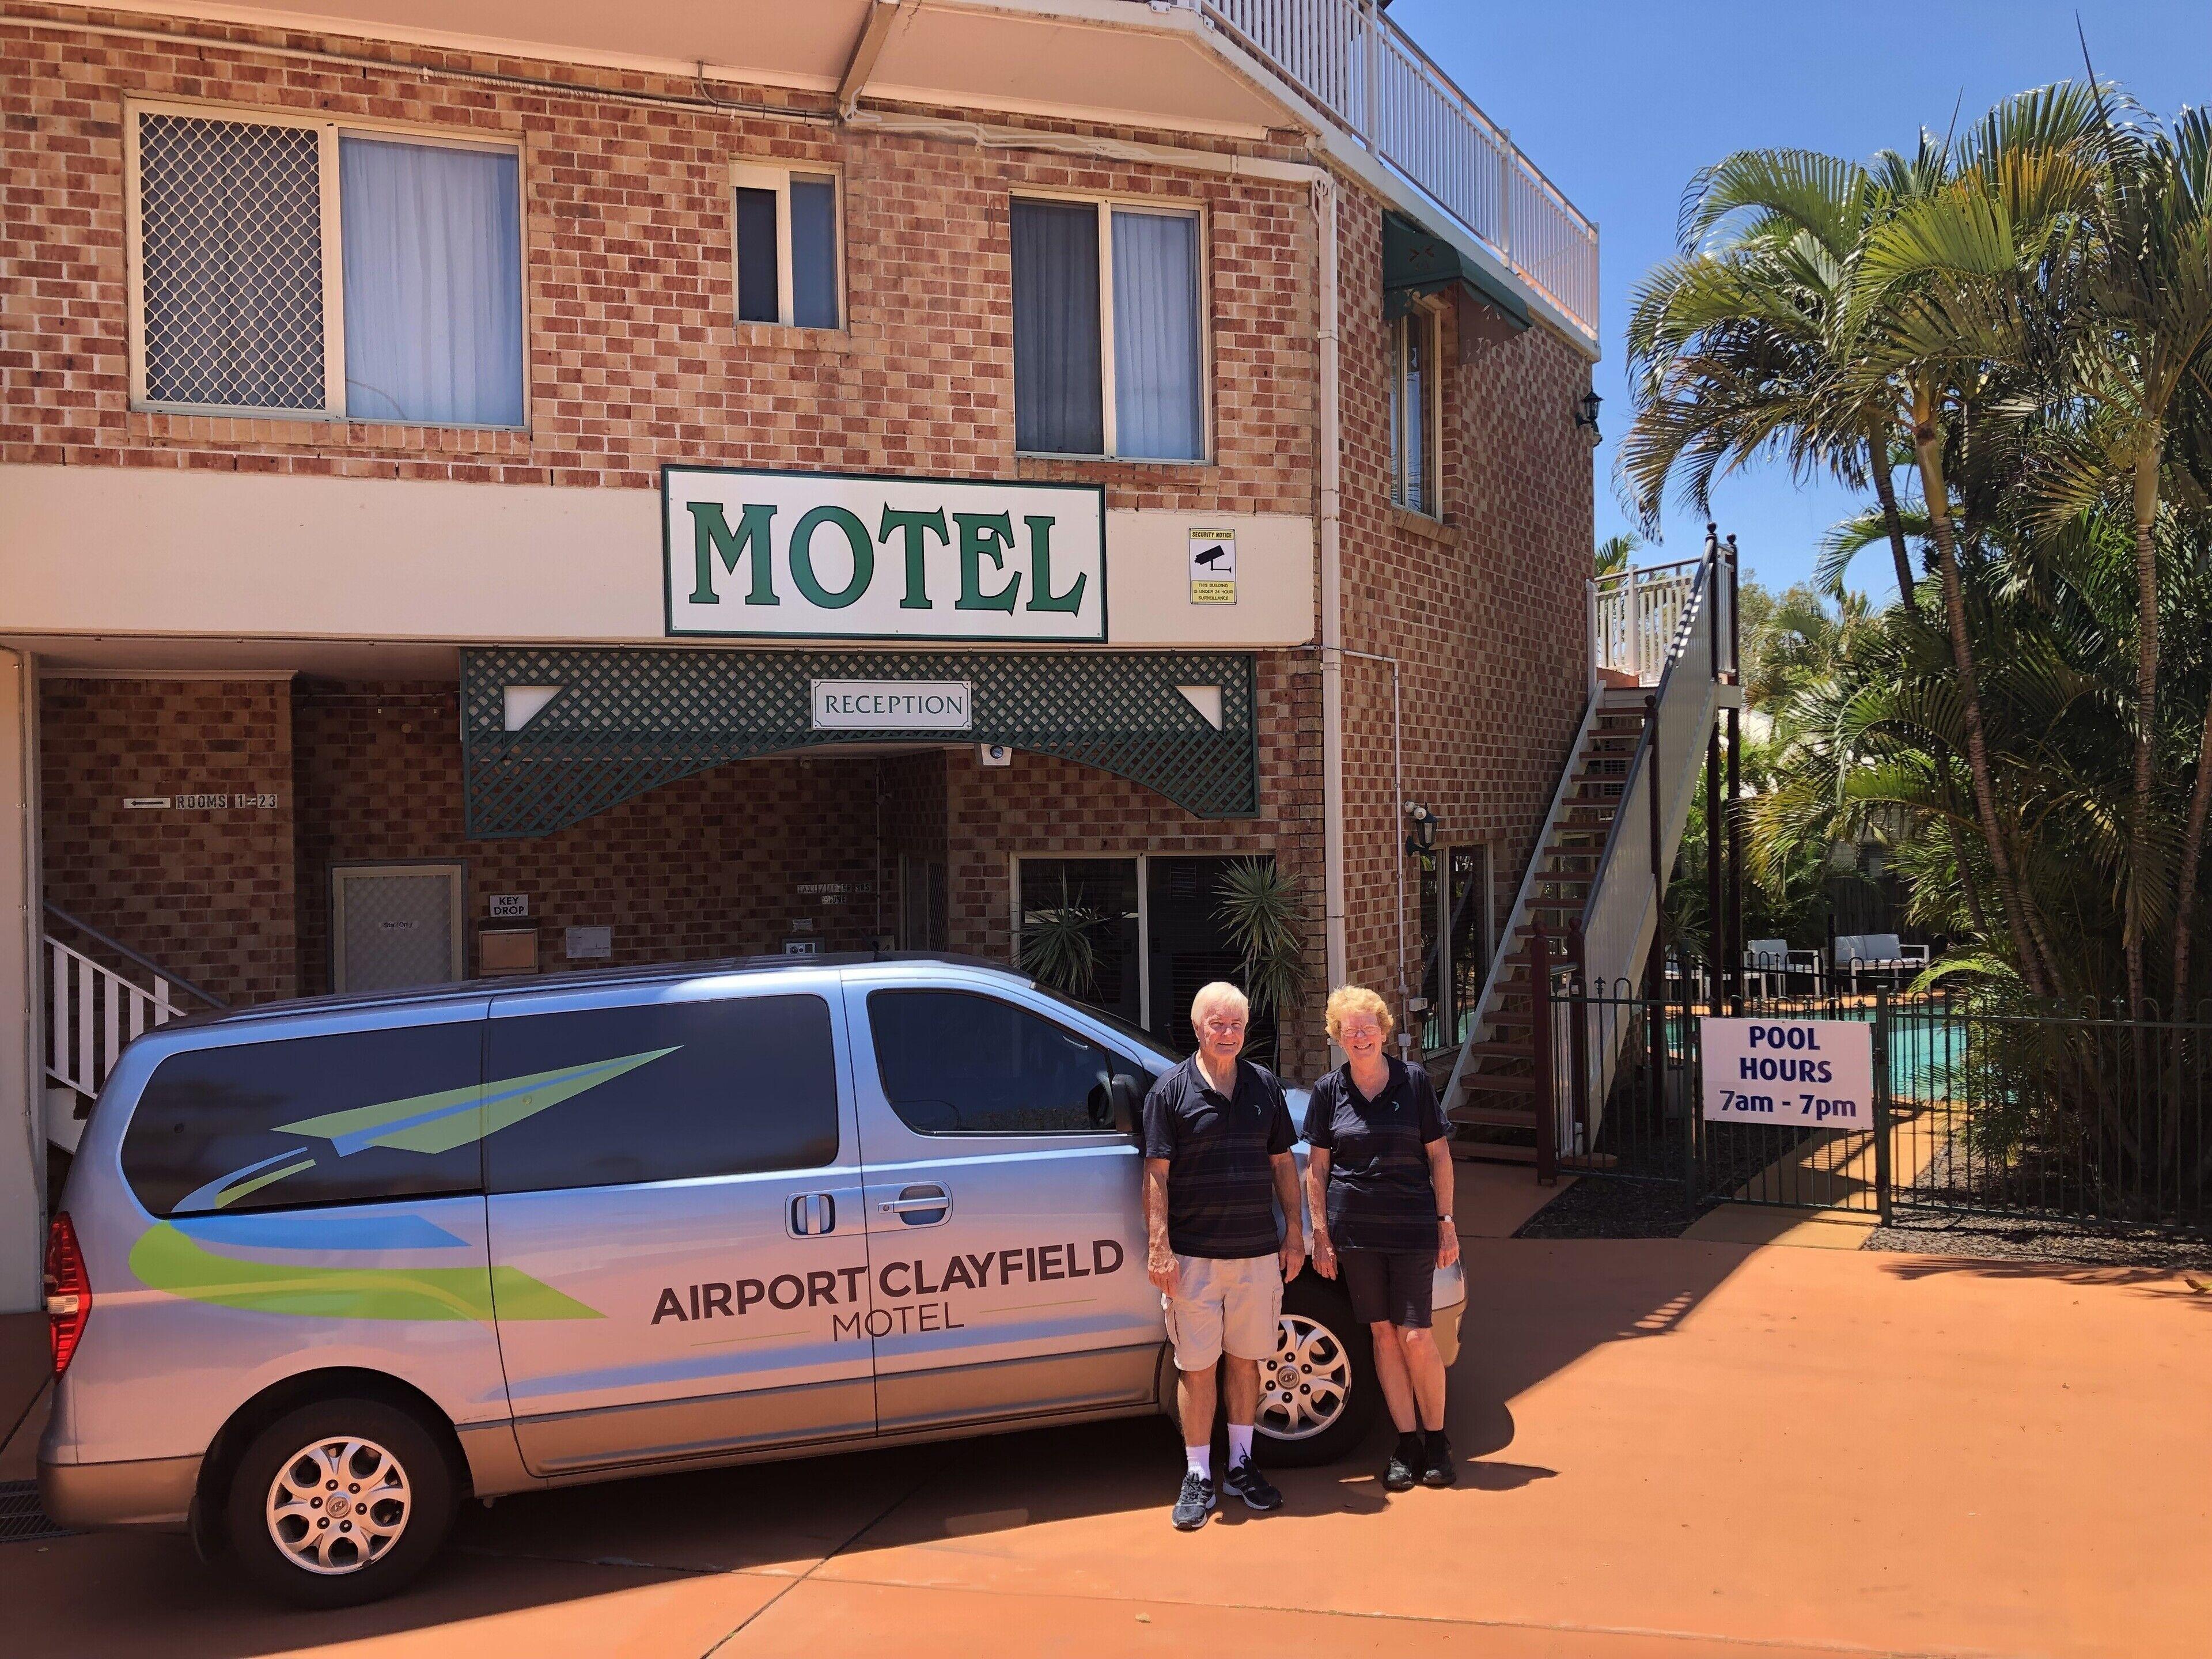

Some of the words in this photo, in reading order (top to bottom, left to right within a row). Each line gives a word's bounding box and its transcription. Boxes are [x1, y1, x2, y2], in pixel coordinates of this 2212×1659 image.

[686, 501, 1087, 618] MOTEL
[825, 695, 963, 714] RECEPTION
[176, 795, 226, 808] ROOMS
[856, 884, 870, 892] HRS
[494, 906, 524, 915] DROP
[499, 896, 519, 905] KEY
[1749, 1026, 1820, 1050] POOL
[1740, 1058, 1832, 1082] HOURS
[1719, 1090, 1774, 1112] 7am
[1799, 1094, 1856, 1120] 7pm
[651, 1266, 869, 1325] AIRPORT
[879, 1239, 1124, 1298] CLAYFIELD
[832, 1301, 964, 1342] MOTEL
